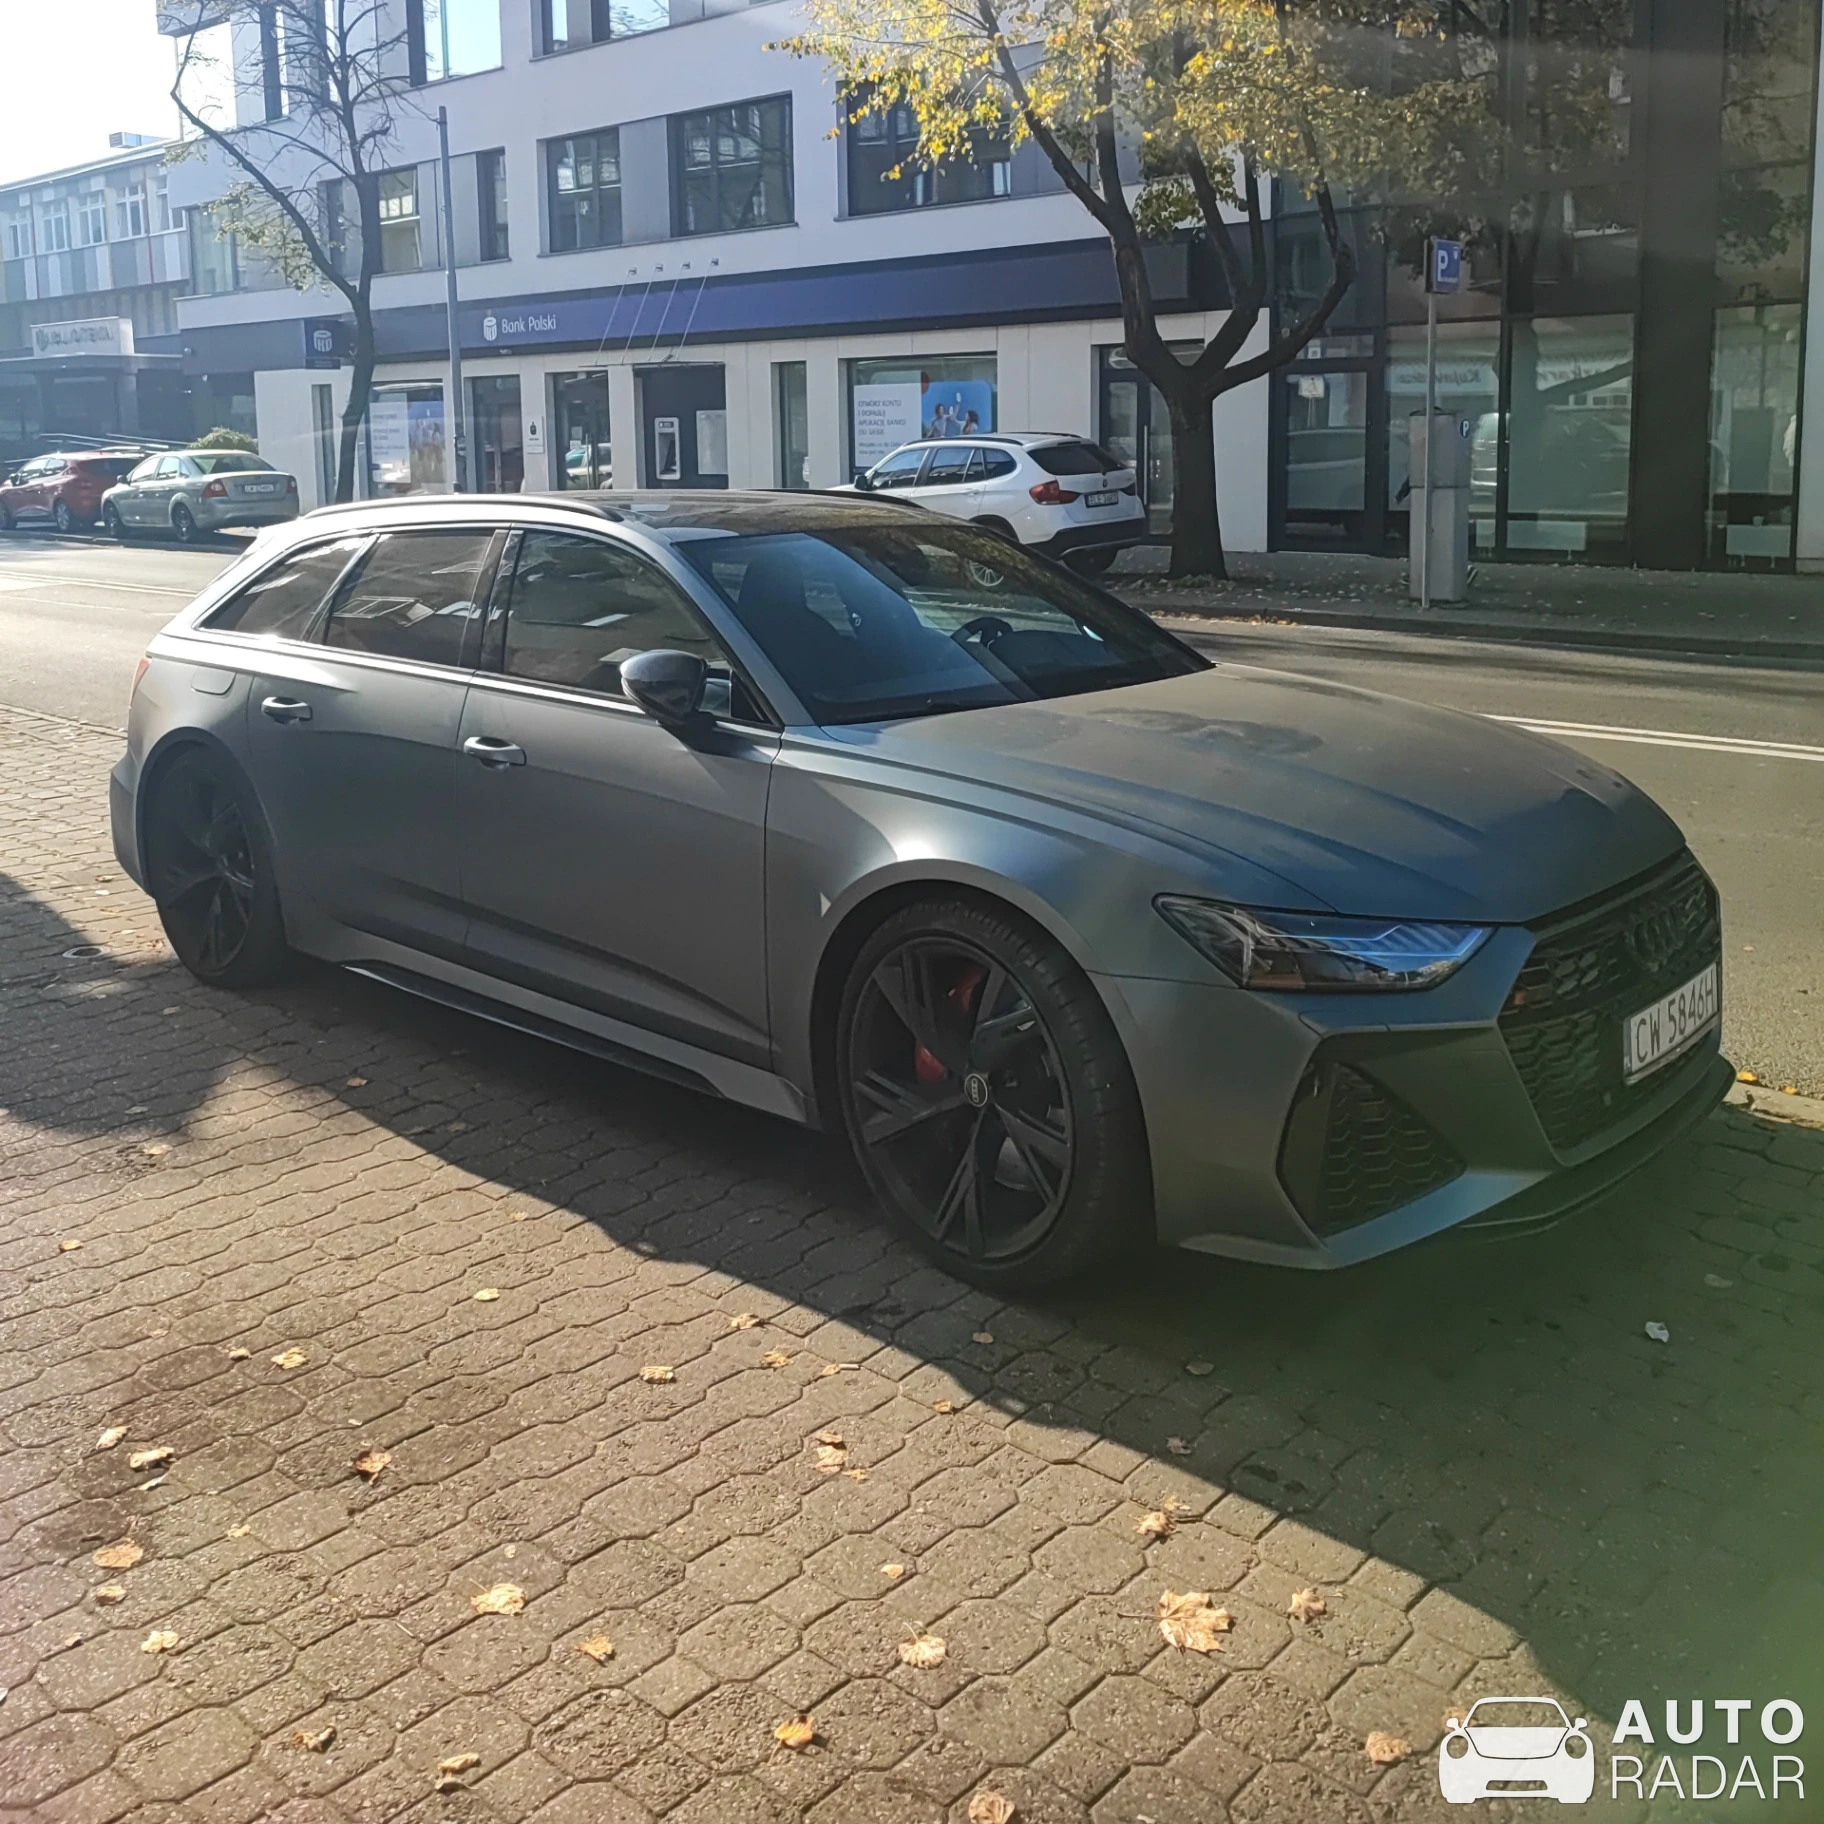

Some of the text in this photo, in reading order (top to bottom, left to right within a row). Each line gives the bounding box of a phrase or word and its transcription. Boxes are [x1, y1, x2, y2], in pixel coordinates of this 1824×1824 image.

[501, 318, 526, 334] Bank
[528, 314, 557, 332] Polski
[1463, 420, 1470, 437] P
[1636, 969, 1715, 1063] CW 5846H
